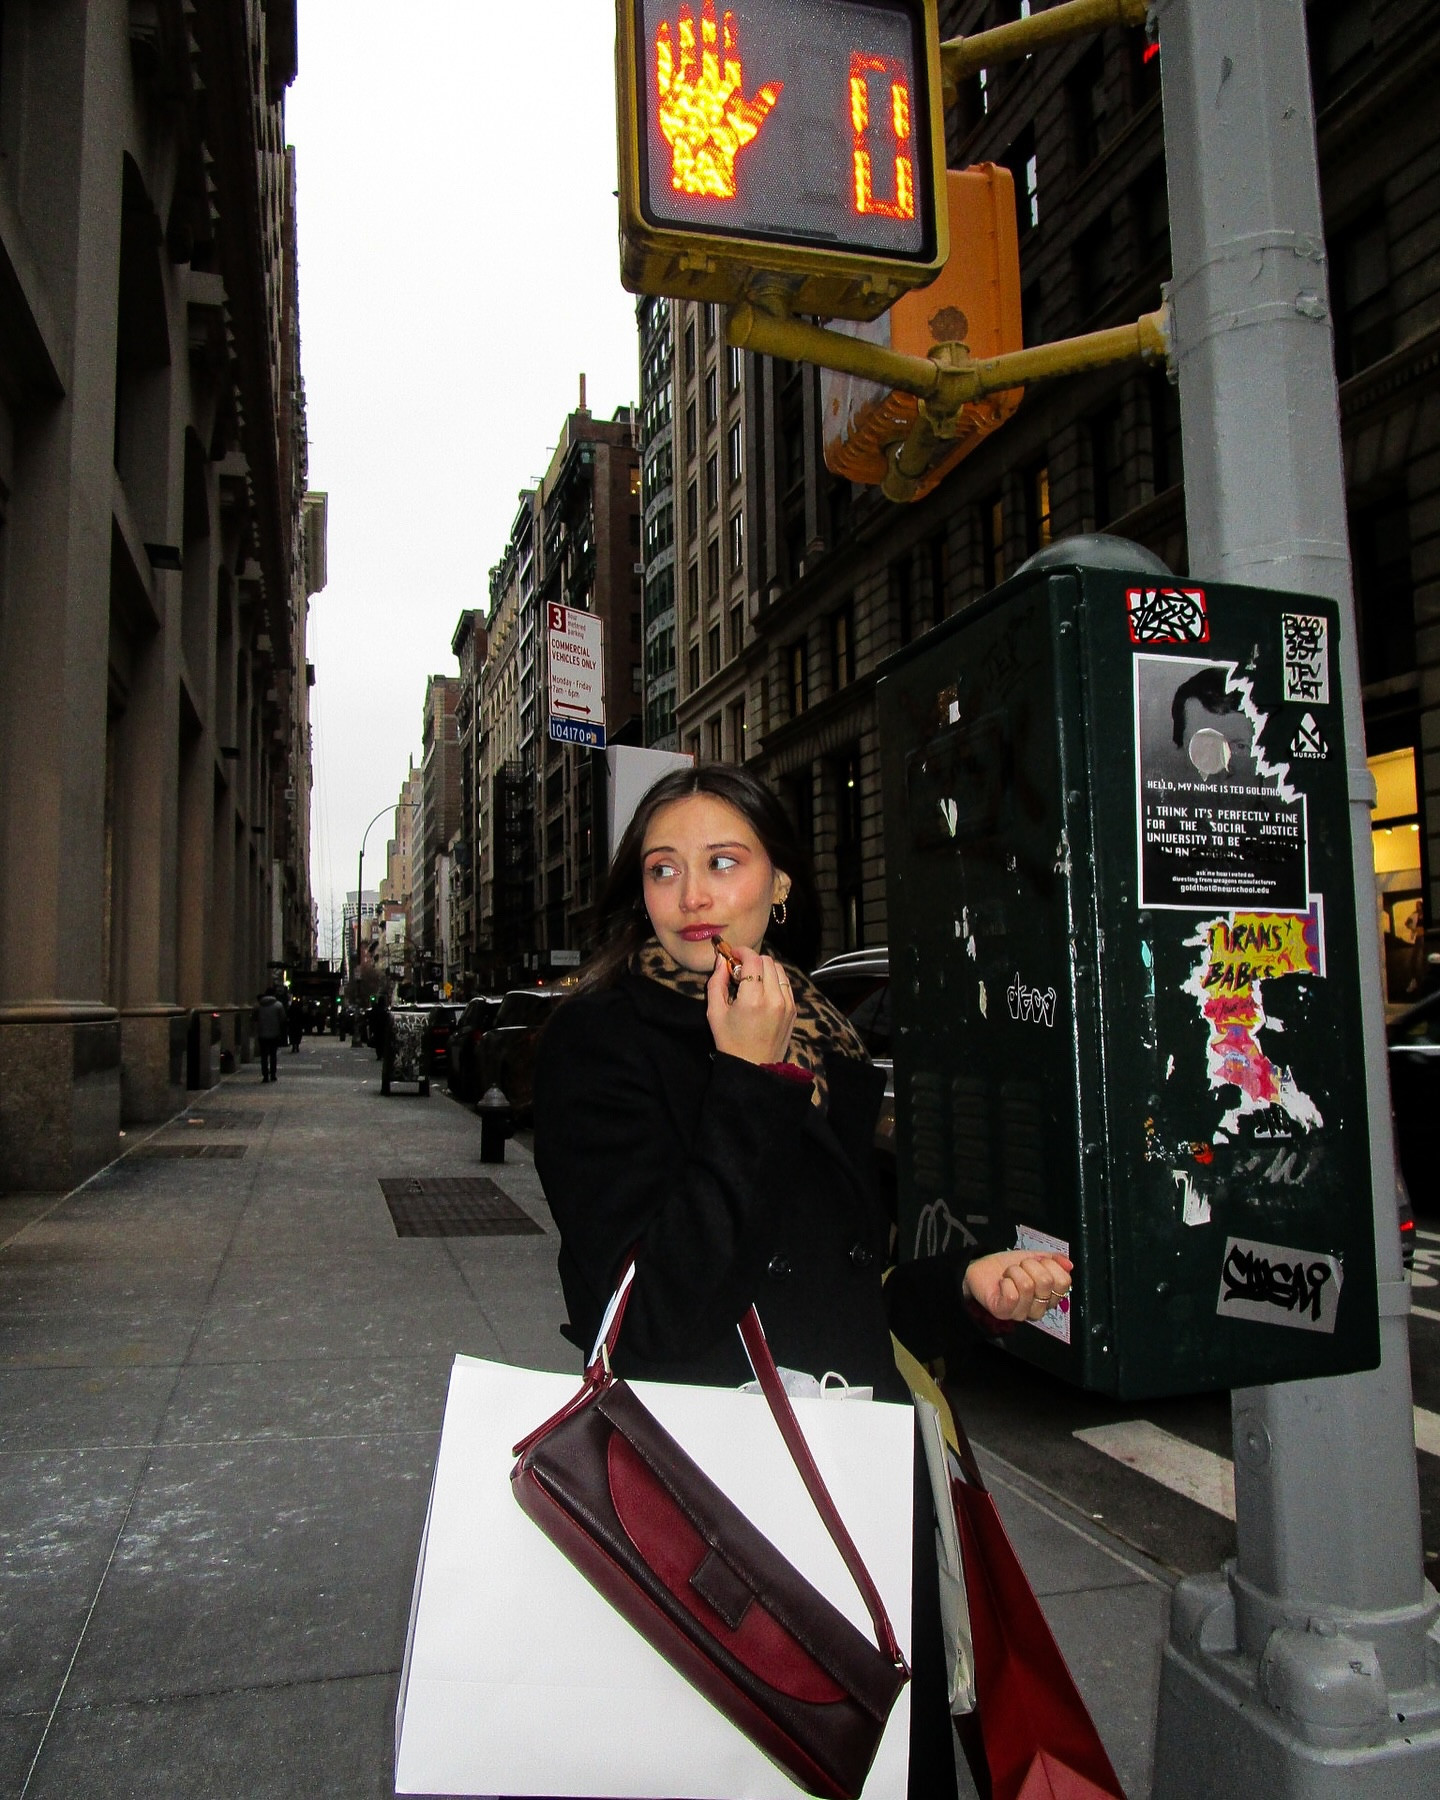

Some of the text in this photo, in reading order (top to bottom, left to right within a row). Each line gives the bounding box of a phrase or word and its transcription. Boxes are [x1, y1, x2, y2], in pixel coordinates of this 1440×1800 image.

[553, 608, 562, 629] 3
[552, 638, 590, 657] COMMERCIAL
[552, 650, 580, 666] VEHICLES
[582, 658, 597, 670] ONLY
[552, 675, 572, 687] Monday
[576, 680, 592, 692] Friday
[568, 689, 580, 698] 6pm
[552, 724, 585, 742] 104170
[1147, 780, 1281, 796] HELLO, MY NAME IS TED GOLDTHO
[1147, 805, 1298, 823] I THINK IT'S PERFECTLY FINE
[1147, 819, 1298, 836] FOR THE SOCIAL JUSTICE
[1147, 832, 1207, 845] UNIVERSITY
[1212, 835, 1223, 846] TO
[1228, 836, 1240, 847] BE
[1175, 847, 1190, 857] AN
[1172, 876, 1198, 884] divesting
[1180, 884, 1270, 894] goldthot@newschool.edu
